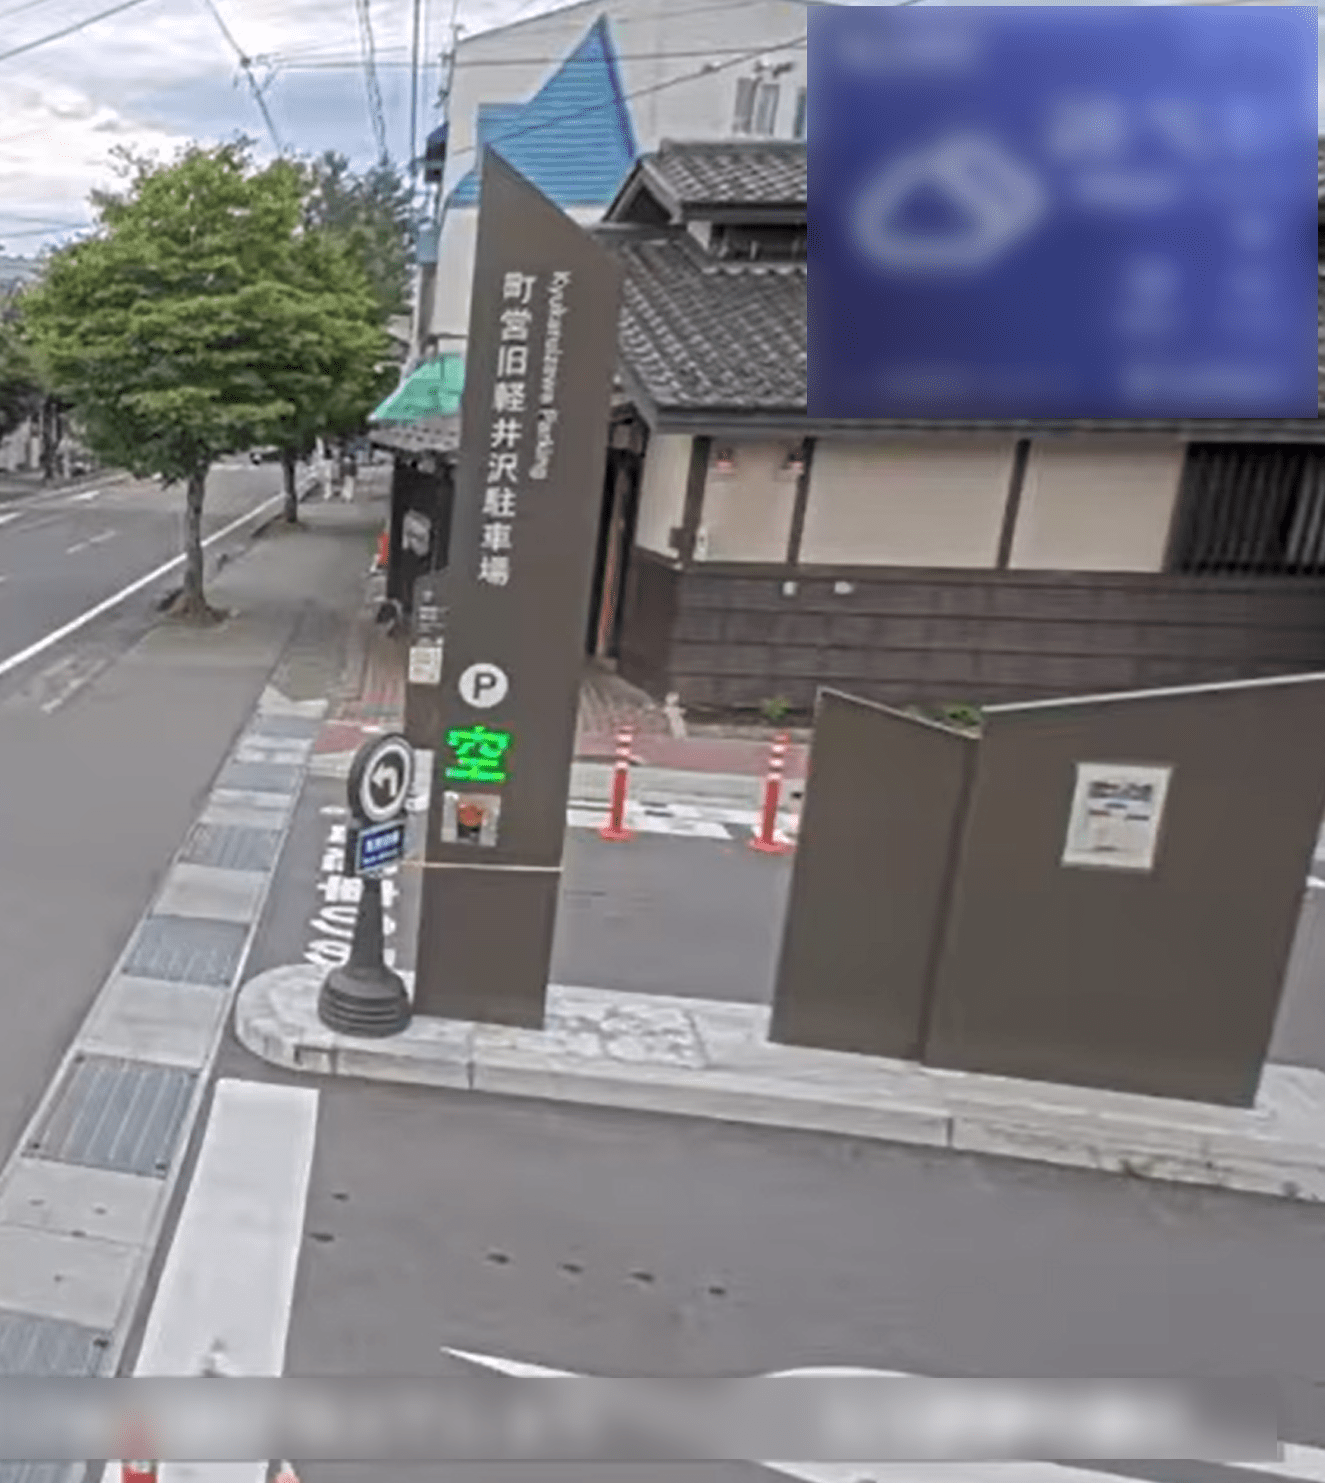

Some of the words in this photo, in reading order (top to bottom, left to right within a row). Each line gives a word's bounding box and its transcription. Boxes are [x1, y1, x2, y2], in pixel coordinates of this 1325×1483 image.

[539, 270, 572, 405] Kyukaruizawa
[477, 271, 537, 586] 町営旧軽井沢駐車場
[529, 408, 559, 480] Parking
[473, 672, 498, 700] P
[445, 725, 510, 782] 空
